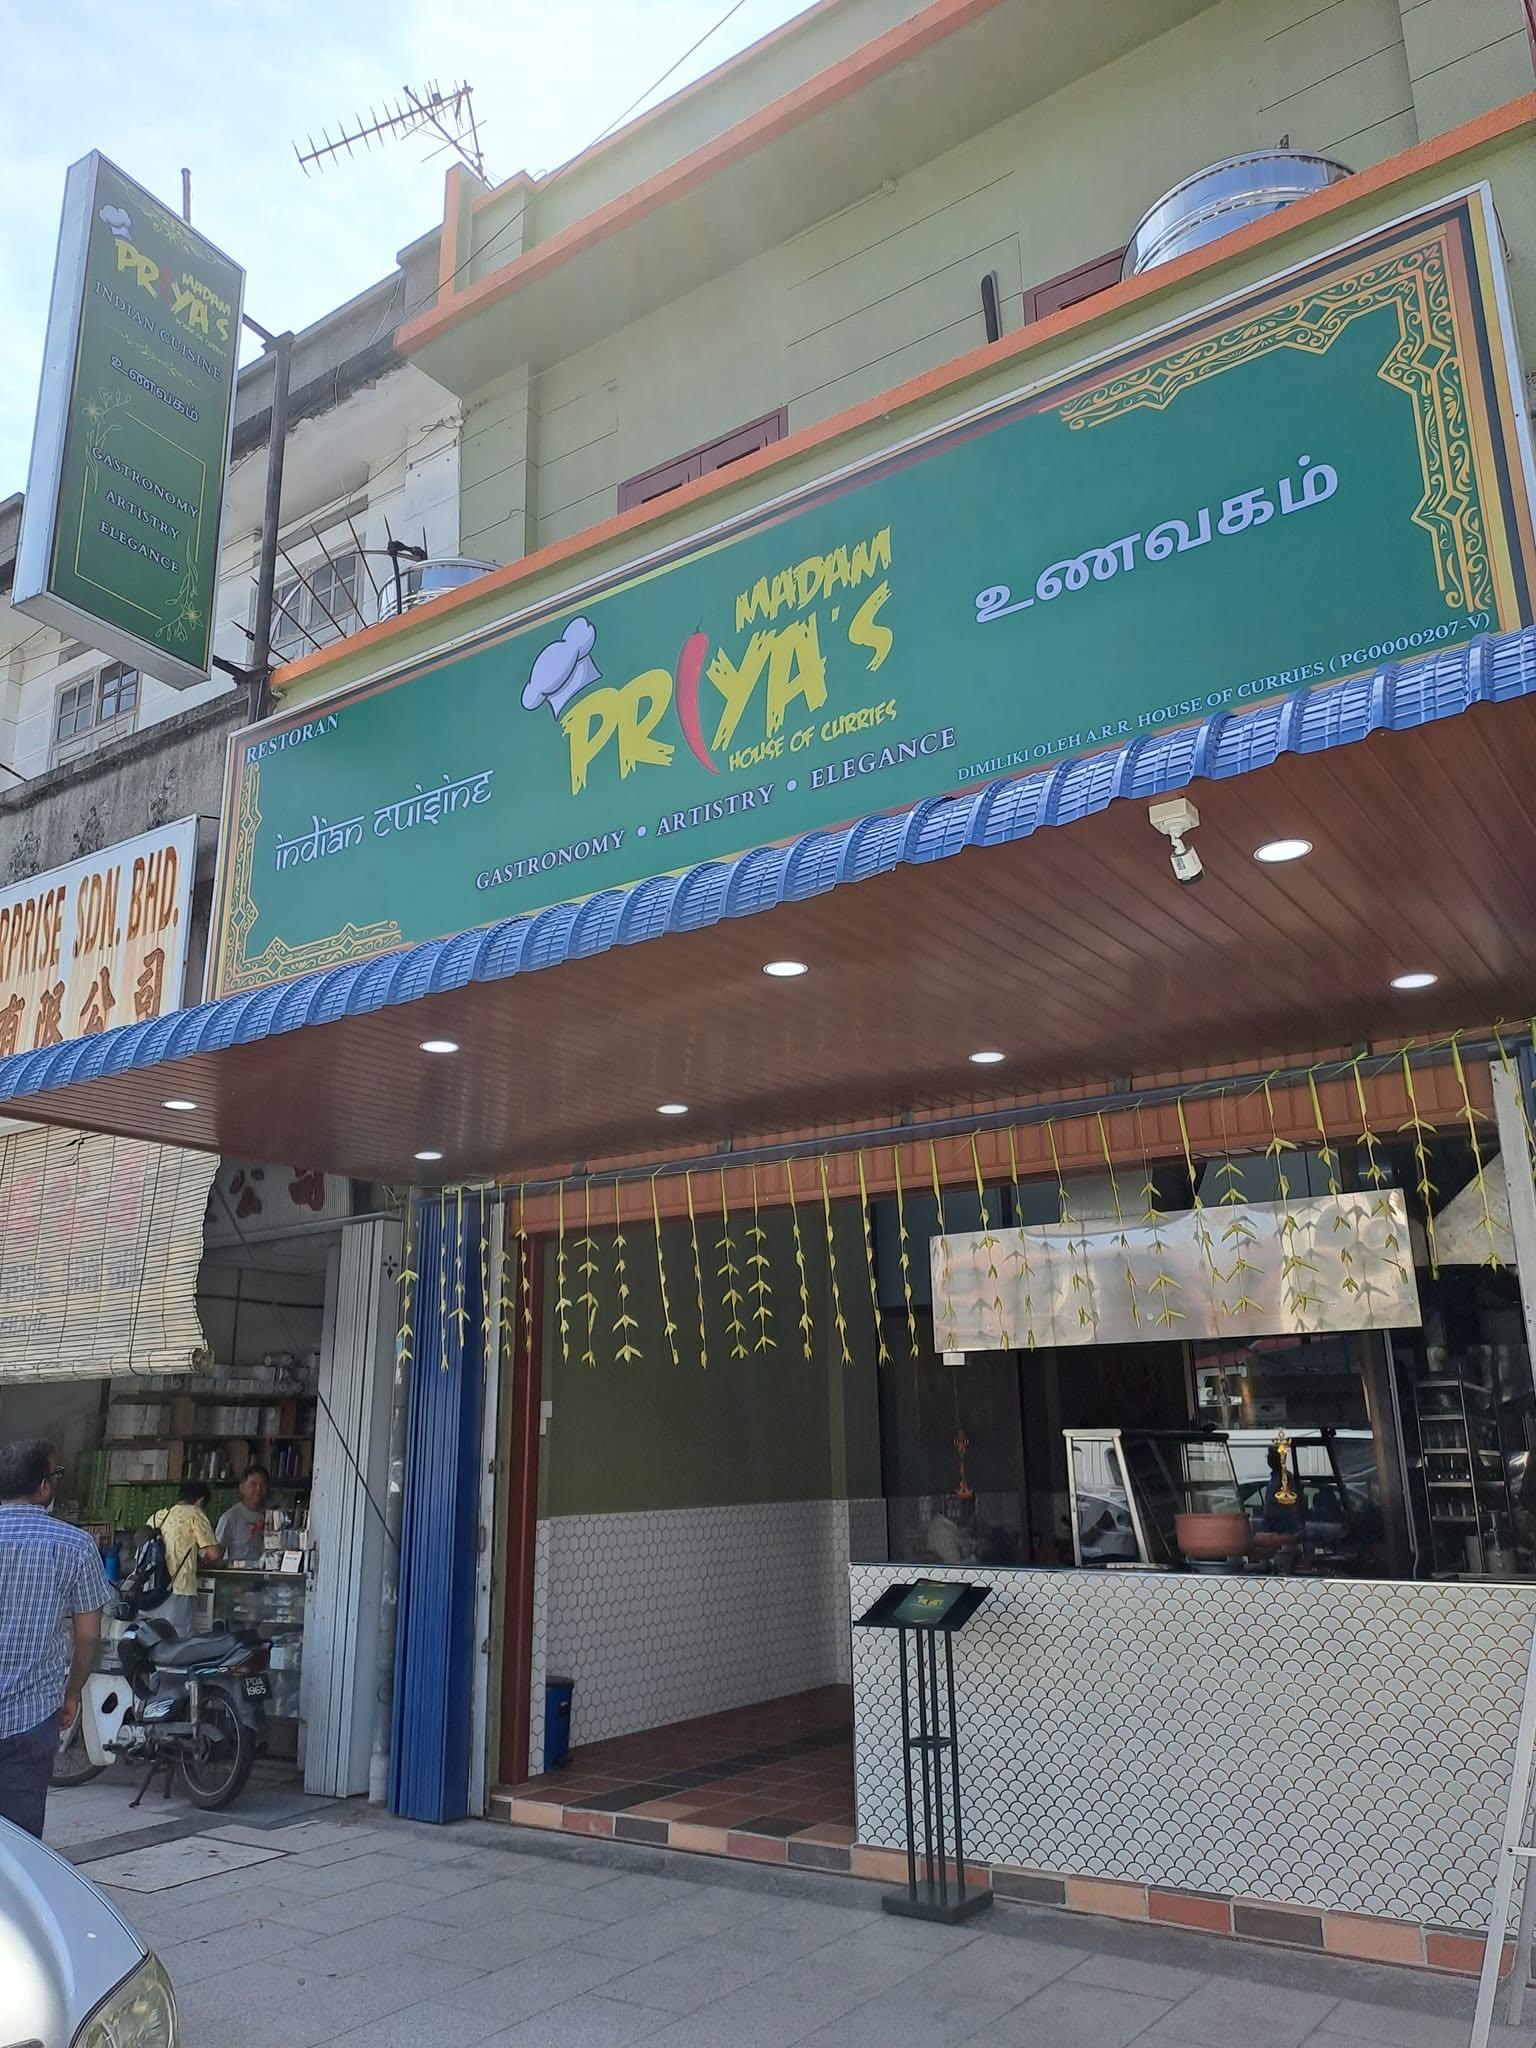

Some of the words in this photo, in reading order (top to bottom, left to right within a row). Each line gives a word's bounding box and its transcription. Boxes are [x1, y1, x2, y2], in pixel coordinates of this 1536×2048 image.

[95, 281, 156, 333] INDIAN
[158, 327, 223, 382] CUISINE
[181, 272, 232, 317] MADAM
[110, 354, 200, 423] உணவகம்
[91, 446, 200, 520] GASTRONOMY
[105, 490, 181, 541] ARTISTRY
[99, 520, 180, 575] ELEGANCE
[973, 452, 1340, 625] உணவகம்
[734, 525, 892, 633] MADAM
[244, 711, 340, 764] RESTORAN
[728, 736, 785, 772] HOUSE
[789, 724, 816, 753] OF
[820, 698, 897, 742] CURRIES
[957, 748, 1030, 781] DIMILIKI
[1032, 733, 1082, 759] OLEH
[1085, 719, 1133, 743] A.R.R.
[1137, 696, 1203, 728] HOUSE
[1206, 686, 1234, 708] OF
[1236, 661, 1325, 698] CURRIES
[475, 828, 627, 892] GASTRONOMY
[655, 782, 777, 837] ARTISTRY
[808, 726, 958, 791] ELEGANCE
[72, 865, 121, 959] SDN.
[126, 845, 179, 942] BHD.
[246, 1685, 268, 1697] 1965
